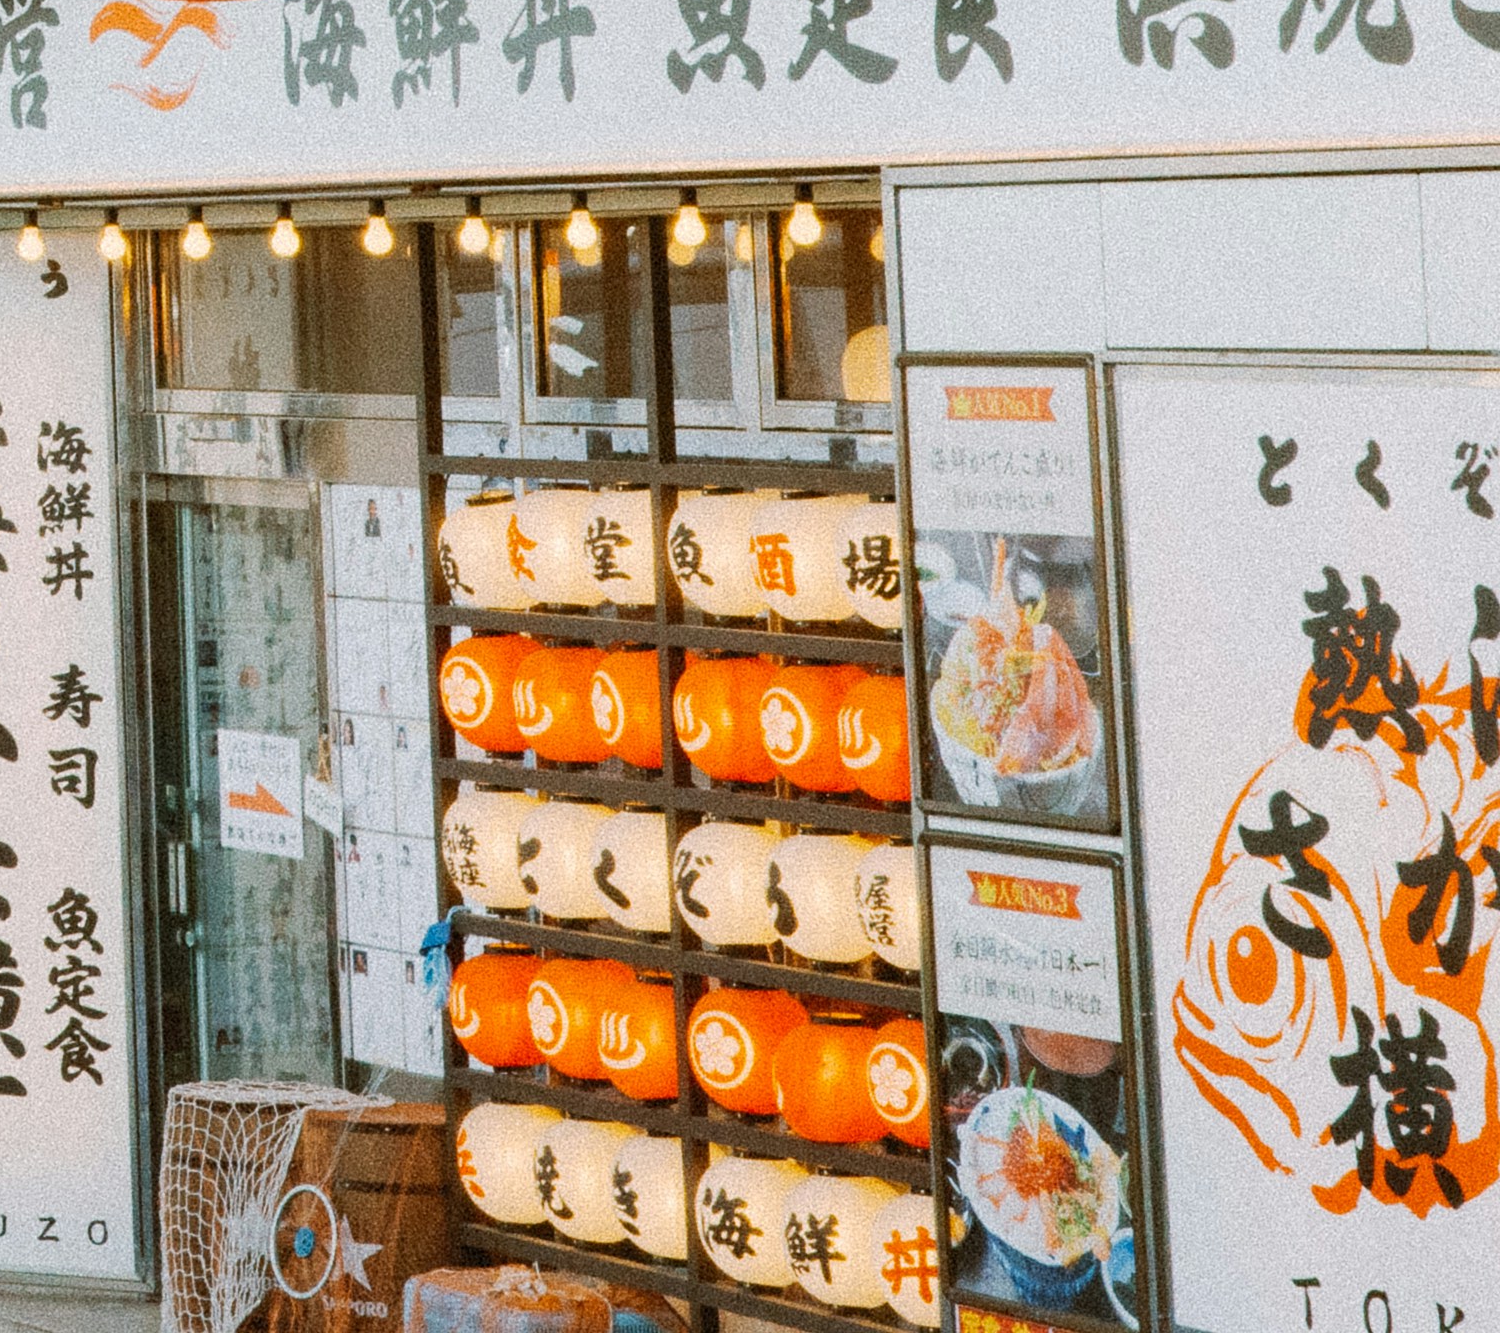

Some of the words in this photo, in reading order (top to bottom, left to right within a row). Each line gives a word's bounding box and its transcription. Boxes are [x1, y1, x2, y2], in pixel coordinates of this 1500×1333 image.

[34, 417, 96, 603] 海鮮丼
[43, 663, 104, 810] 寿司
[1301, 565, 1500, 768] 熱
[43, 886, 113, 1087] 魚定食
[999, 879, 1069, 915] 人気No.3
